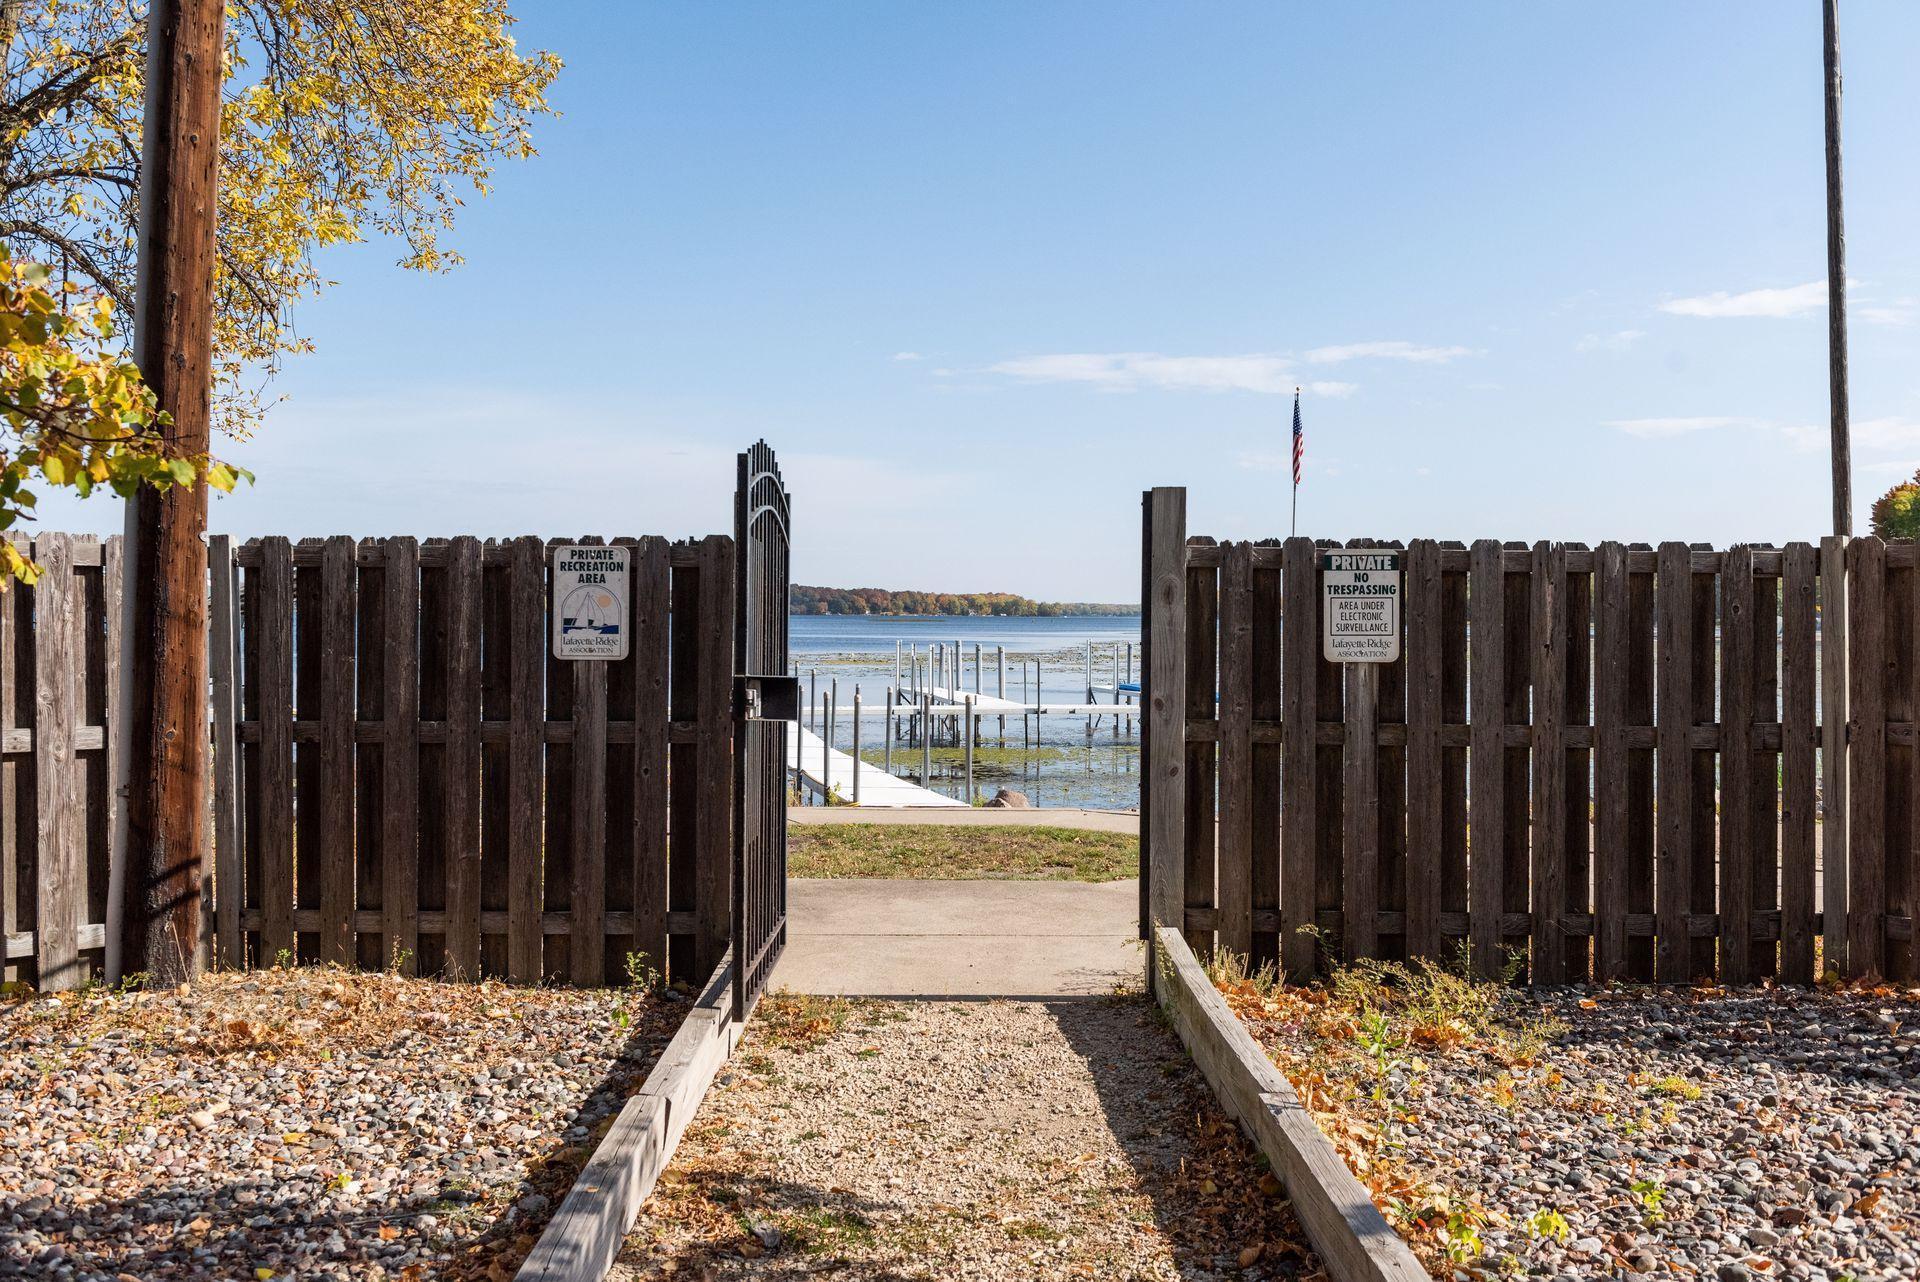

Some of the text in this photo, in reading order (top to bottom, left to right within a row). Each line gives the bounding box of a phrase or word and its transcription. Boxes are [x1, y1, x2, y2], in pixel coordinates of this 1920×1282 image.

[570, 549, 614, 560] PRIVATE
[560, 561, 624, 572] RECREATION
[1331, 555, 1392, 570] PRIVATE
[578, 574, 606, 584] AREA
[1354, 572, 1368, 582] NO
[1327, 584, 1396, 594] TRESPASSING
[1339, 601, 1385, 610] AREA UNDER
[1340, 612, 1384, 621] ELECTRONIC
[1335, 622, 1388, 632] SURVEILLANCE
[562, 636, 619, 648] Lafayette Ridge
[1332, 638, 1392, 650] Lafayette Ridge
